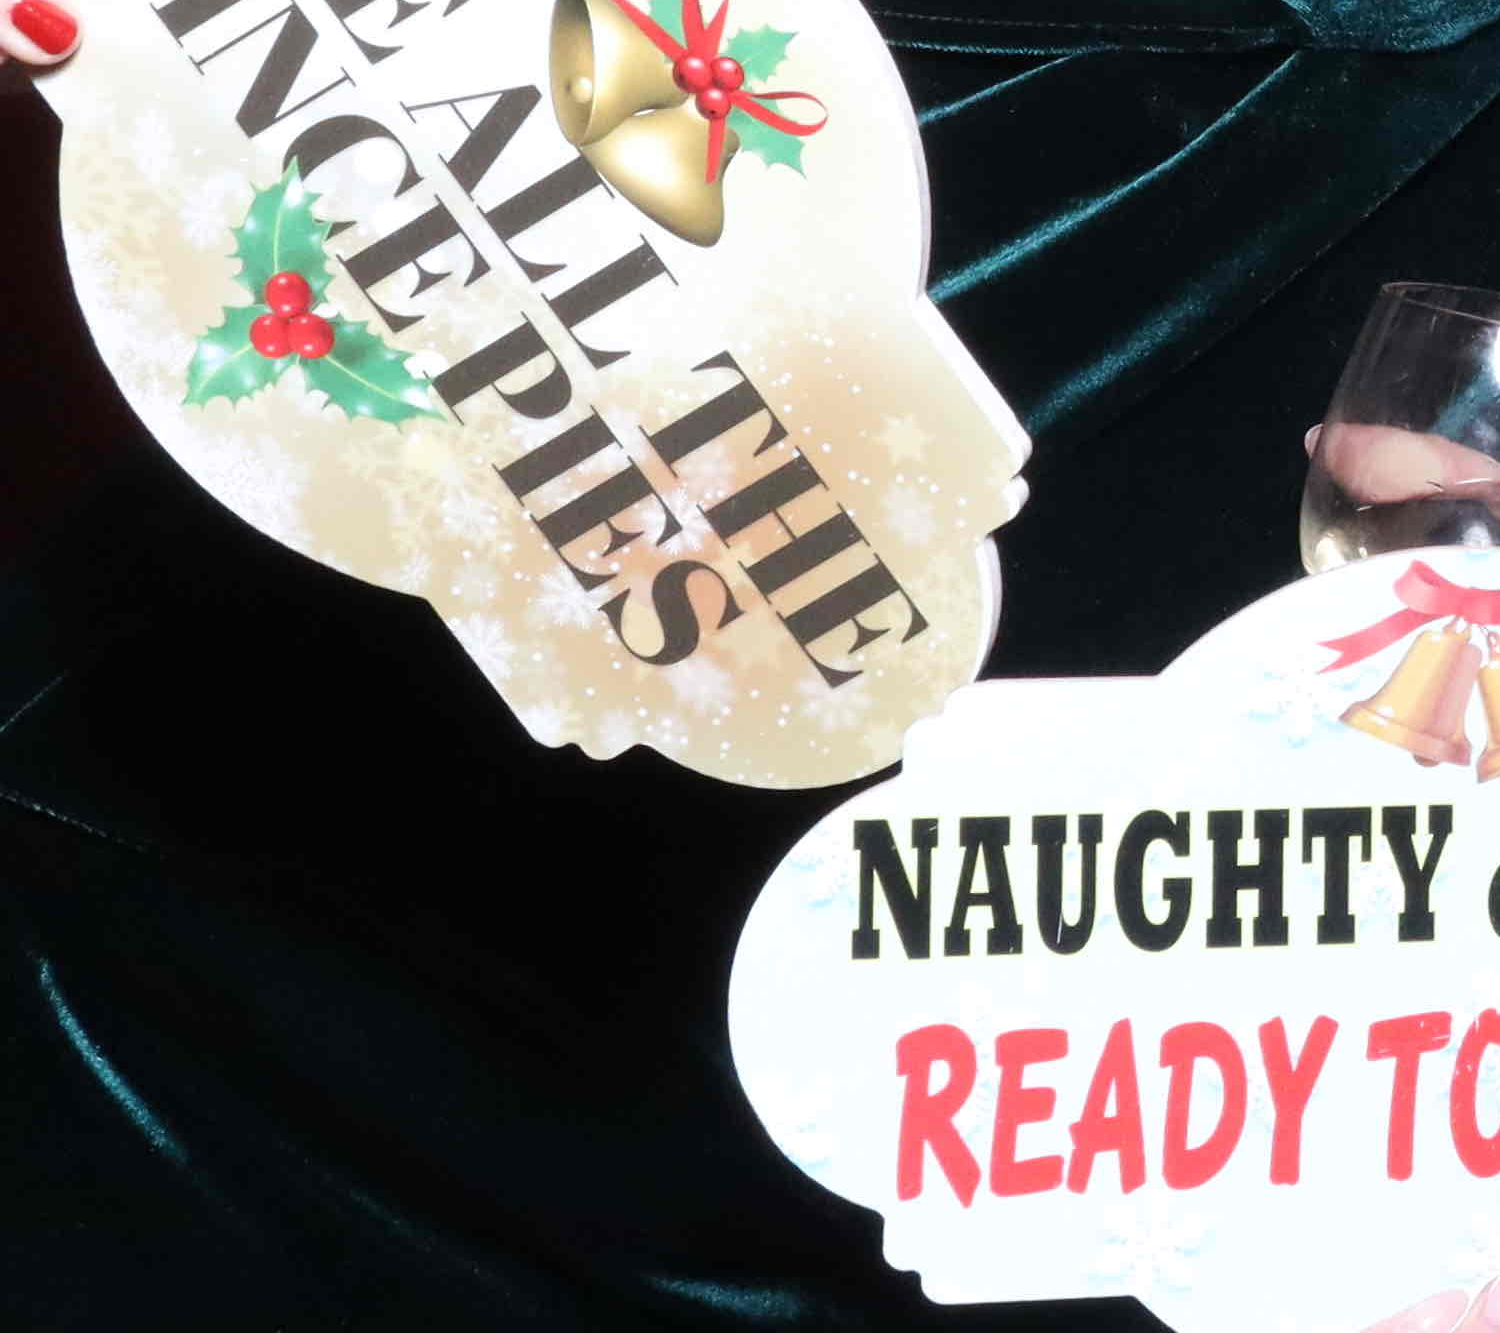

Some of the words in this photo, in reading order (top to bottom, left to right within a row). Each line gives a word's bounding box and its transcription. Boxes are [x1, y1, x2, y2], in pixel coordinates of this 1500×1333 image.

[400, 83, 679, 371] ALL
[638, 350, 930, 689] THE
[423, 310, 748, 666] PIES
[852, 803, 1455, 961] NAUGHTY
[893, 1014, 1341, 1209] READY
